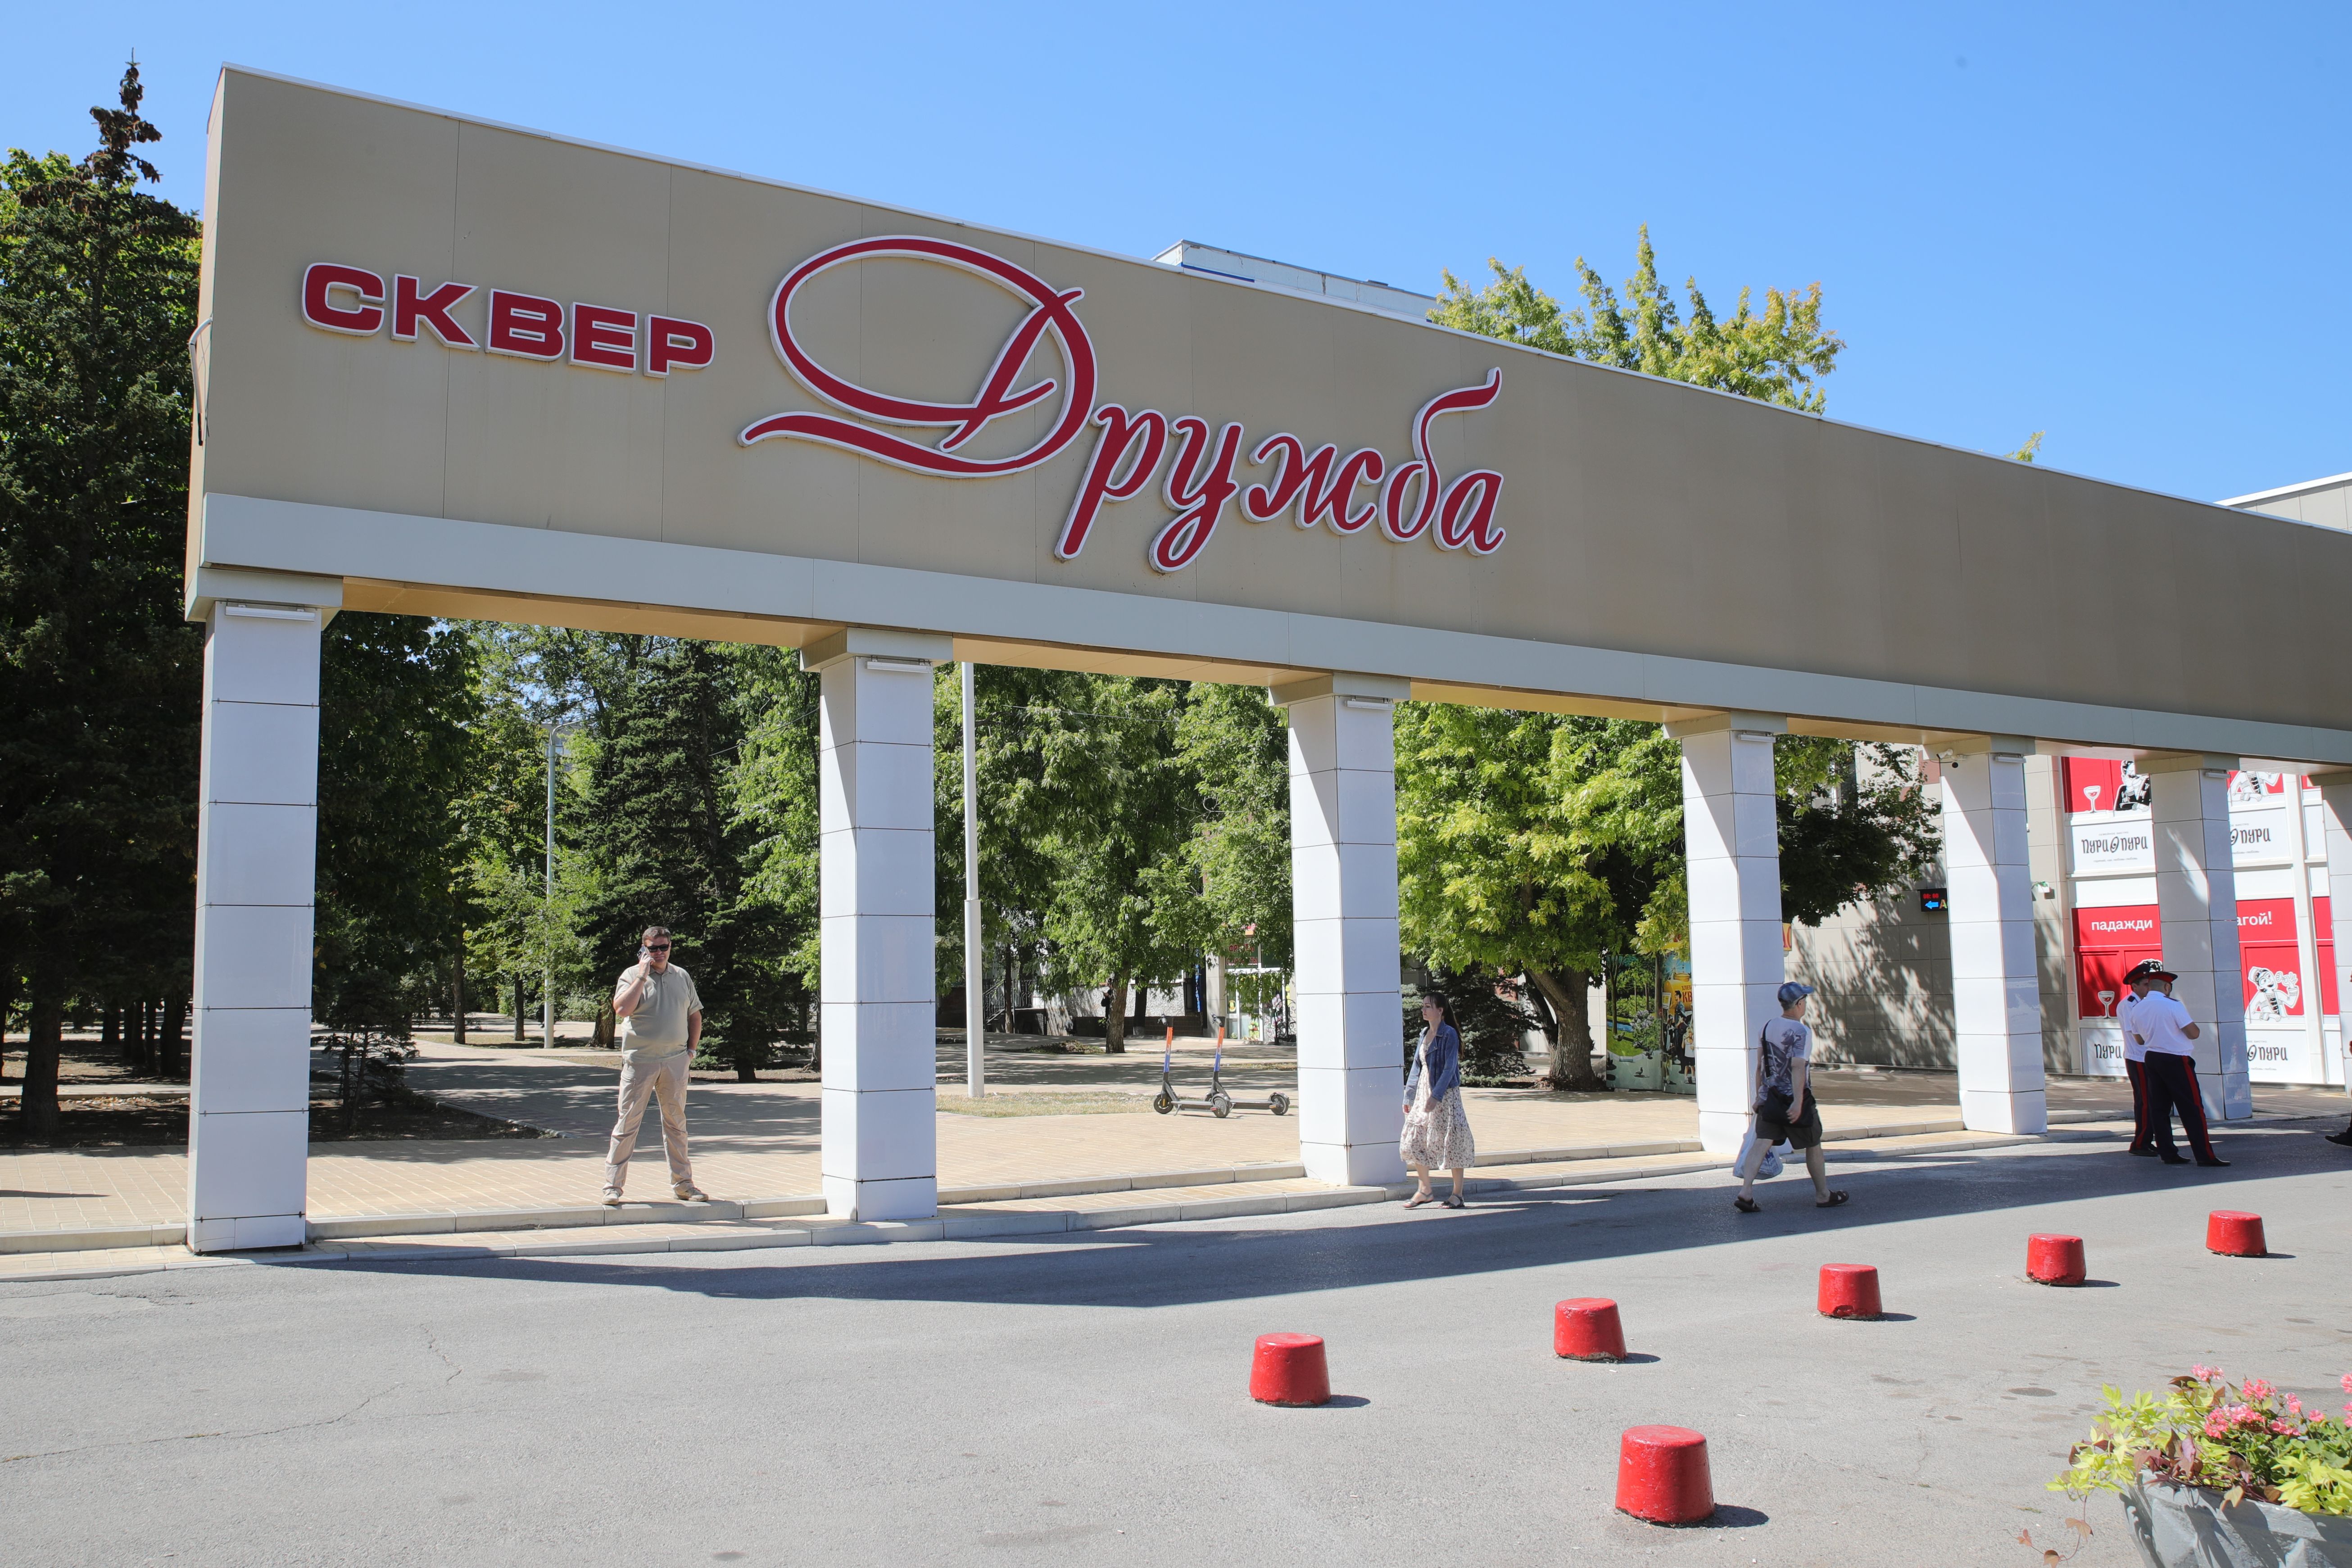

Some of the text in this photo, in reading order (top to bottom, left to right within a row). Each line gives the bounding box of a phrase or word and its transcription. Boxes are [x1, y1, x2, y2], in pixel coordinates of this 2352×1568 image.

[301, 234, 1506, 574] СКВЕР Дружба
[2091, 919, 2153, 932] падажди
